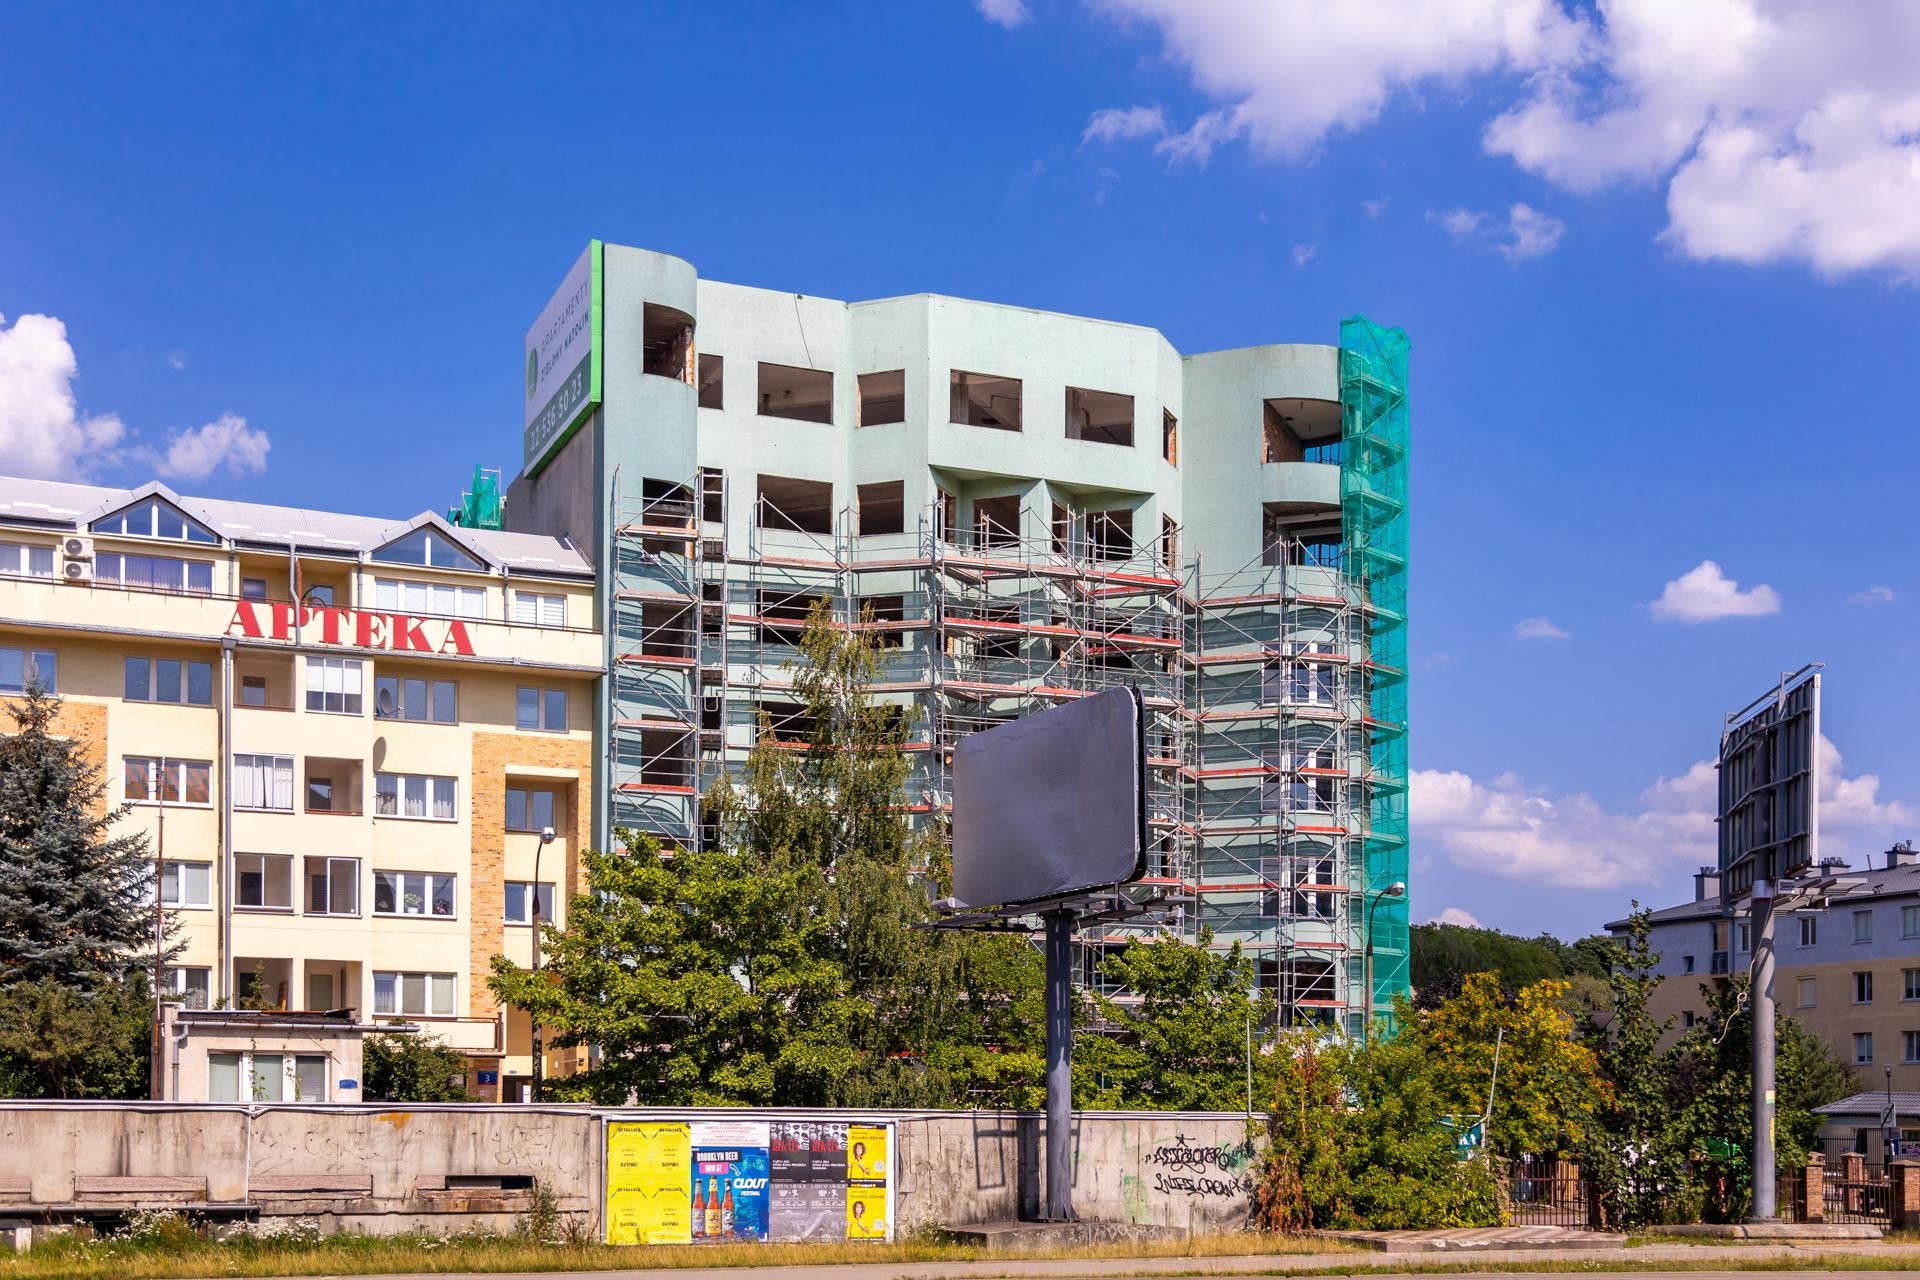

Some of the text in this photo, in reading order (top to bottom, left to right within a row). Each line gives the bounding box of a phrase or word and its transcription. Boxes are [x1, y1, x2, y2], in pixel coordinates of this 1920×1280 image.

[541, 278, 589, 355] APARTAMENTY
[540, 309, 589, 382] ZIELONY NATOLIN
[530, 371, 582, 453] 22 536 50 23
[224, 600, 477, 656] APTEKA
[484, 1074, 490, 1083] 3
[696, 1151, 739, 1162] BROOKLYN BEER
[733, 1178, 768, 1189] CLOUT
